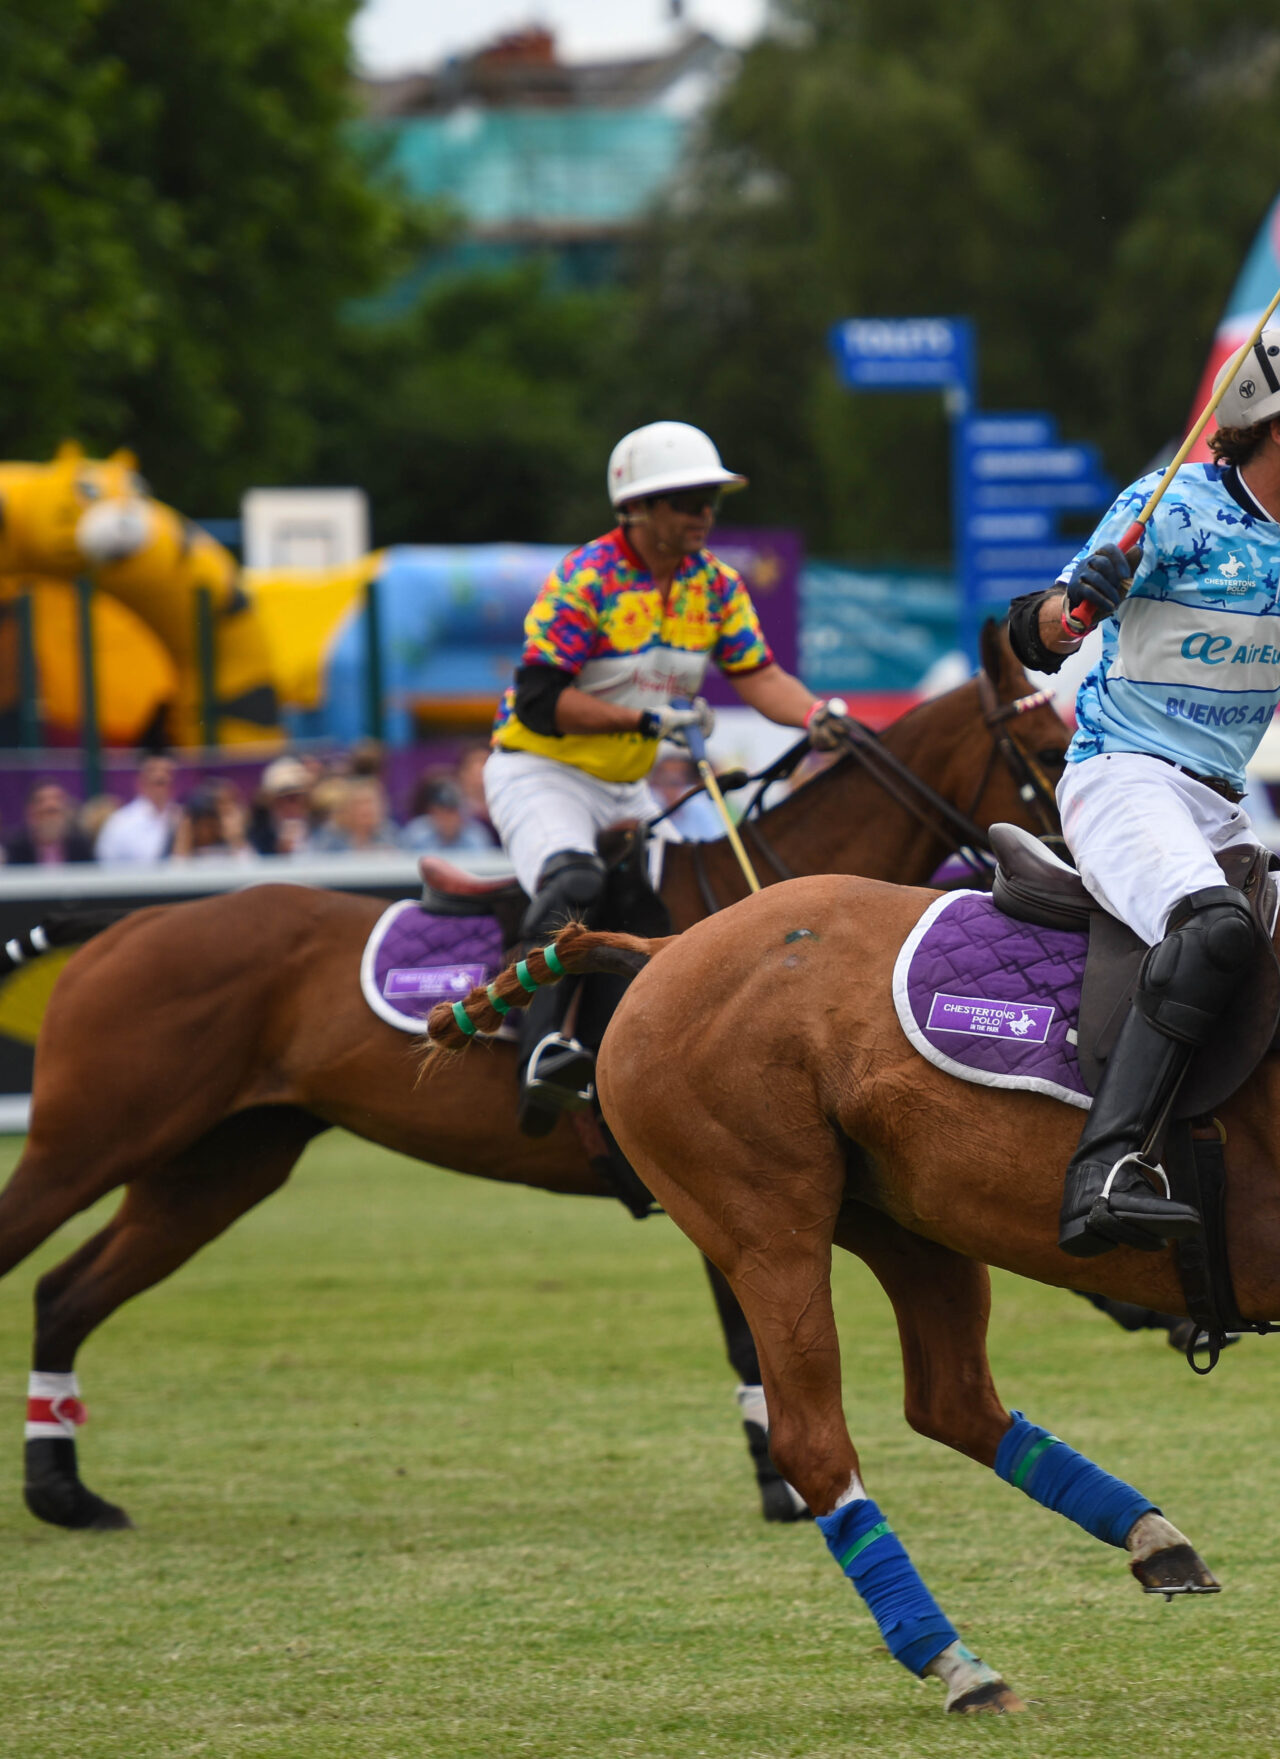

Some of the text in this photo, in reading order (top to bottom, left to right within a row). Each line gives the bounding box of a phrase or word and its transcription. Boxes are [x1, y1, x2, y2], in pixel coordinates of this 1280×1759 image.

[1204, 577, 1257, 588] CHESTERTONS
[1166, 697, 1250, 727] BUENOS
[943, 1003, 1016, 1020] CHESTERTONS
[971, 1015, 1000, 1026] POLO
[986, 1025, 999, 1033] PARK
